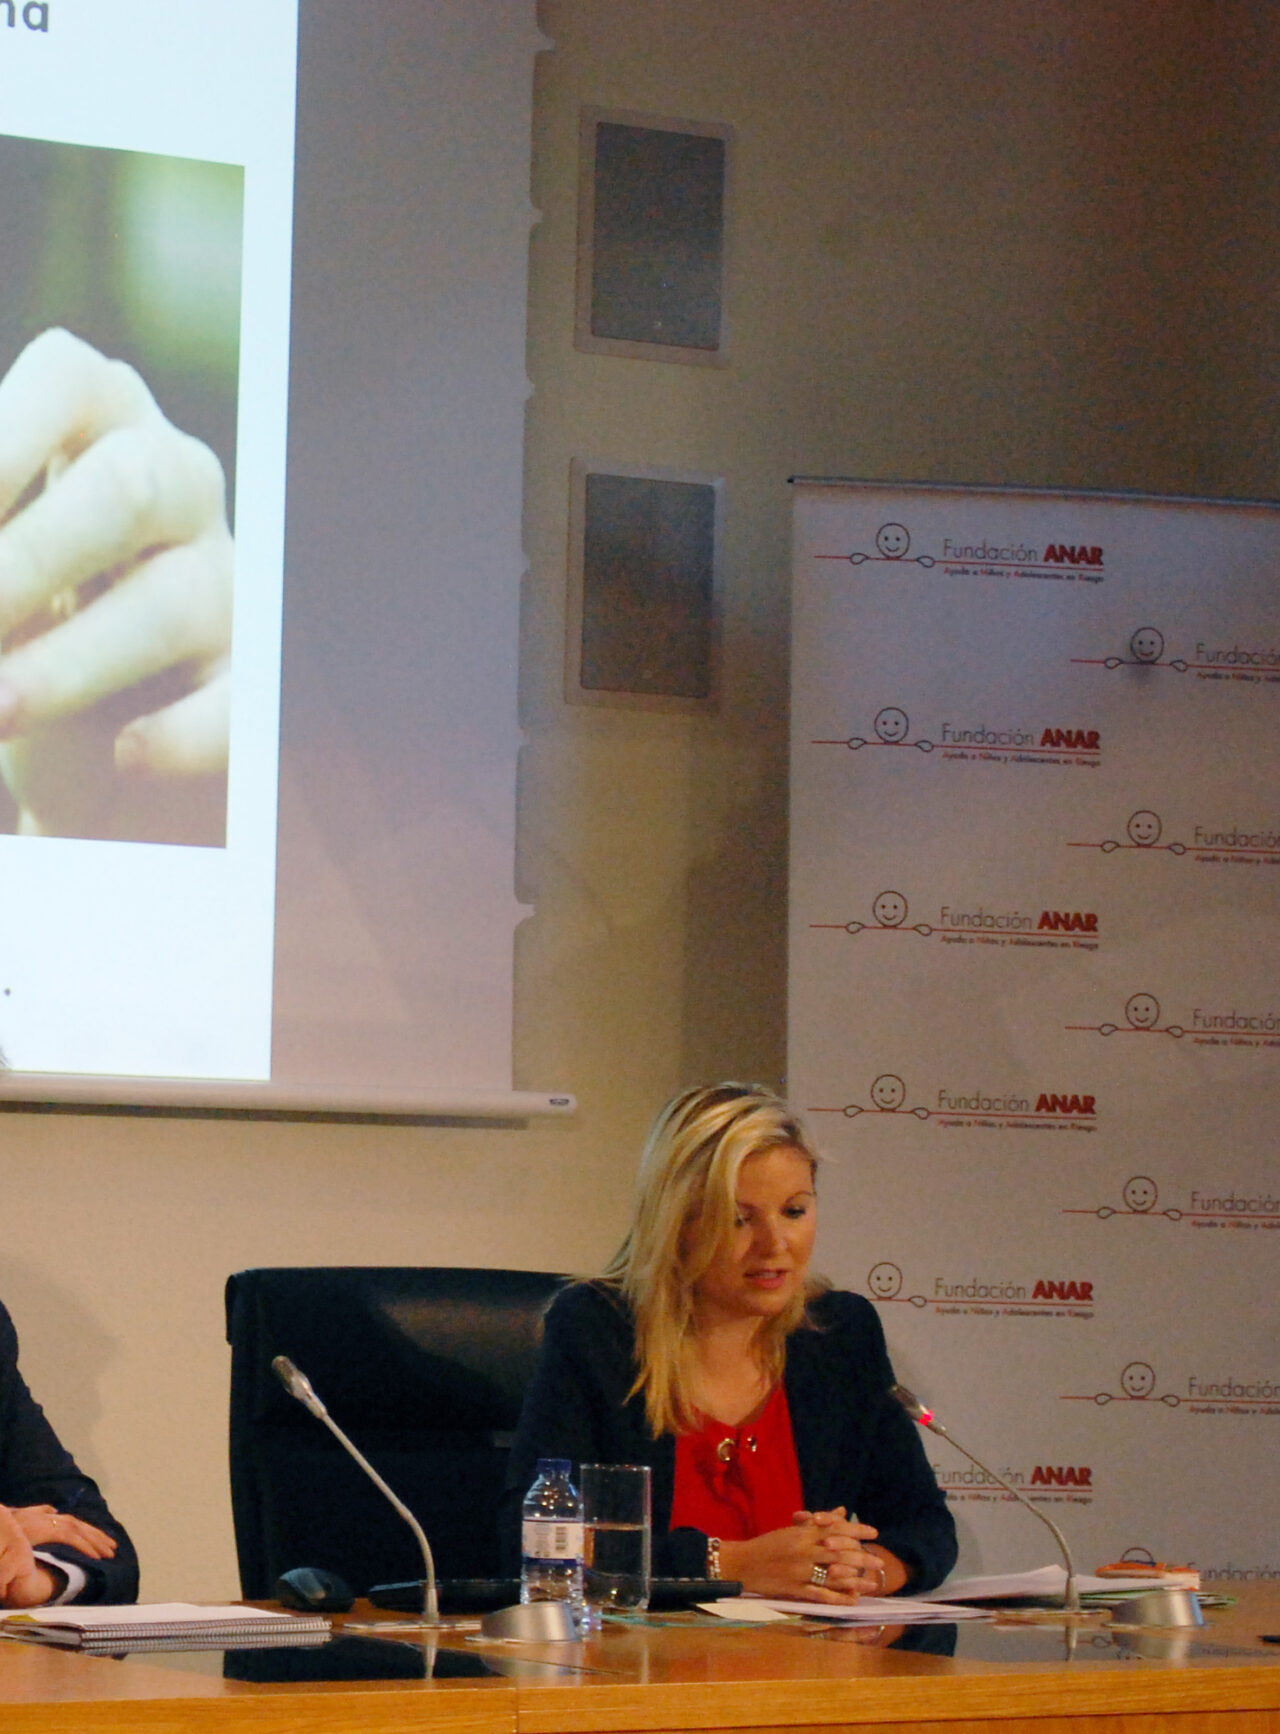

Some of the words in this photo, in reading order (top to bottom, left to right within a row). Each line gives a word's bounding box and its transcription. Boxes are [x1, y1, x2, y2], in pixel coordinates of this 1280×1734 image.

[943, 538, 1038, 562] Fundación
[1043, 543, 1104, 566] ANAR
[1196, 642, 1280, 665] Fundació
[941, 722, 1034, 746] Fundación
[1040, 727, 1100, 750] ANAR
[940, 905, 1033, 930] Fundación
[1037, 910, 1099, 932] ANAR
[937, 1089, 1030, 1112] Fundación
[1035, 1093, 1096, 1114] ANAR
[934, 1277, 1027, 1300] Fundación
[1031, 1279, 1094, 1301] ANAR
[933, 1463, 1024, 1485] Fundacón
[1031, 1465, 1093, 1486] ANAR
